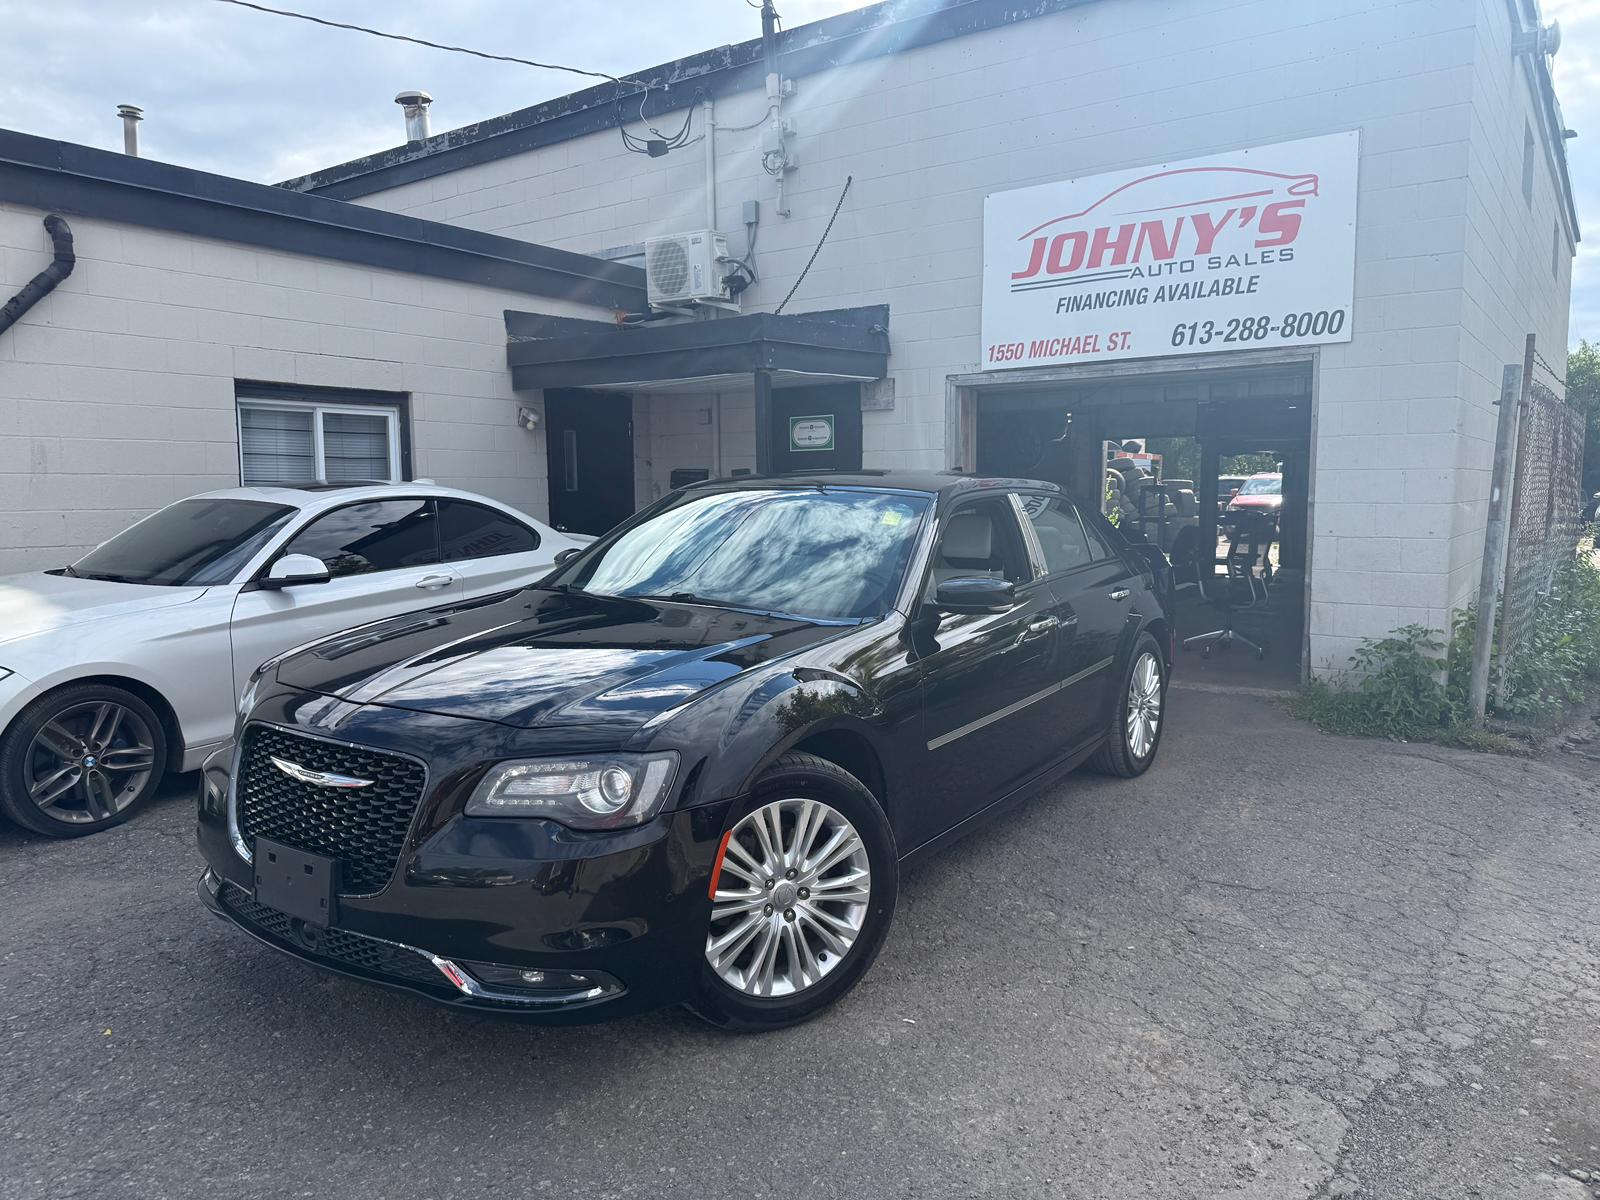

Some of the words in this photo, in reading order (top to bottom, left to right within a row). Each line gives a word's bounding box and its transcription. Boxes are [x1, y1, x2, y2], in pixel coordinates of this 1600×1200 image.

[1011, 199, 1306, 280] JOHNY'S
[1129, 260, 1195, 279] AUTO
[1207, 248, 1294, 269] SALES
[1056, 288, 1148, 313] FINANCING
[1153, 276, 1260, 303] AVAILABLE
[987, 342, 1024, 362] 1550
[1028, 335, 1101, 359] MICHAEL
[1106, 332, 1132, 350] ST.
[1171, 310, 1345, 347] 613-288-8000
